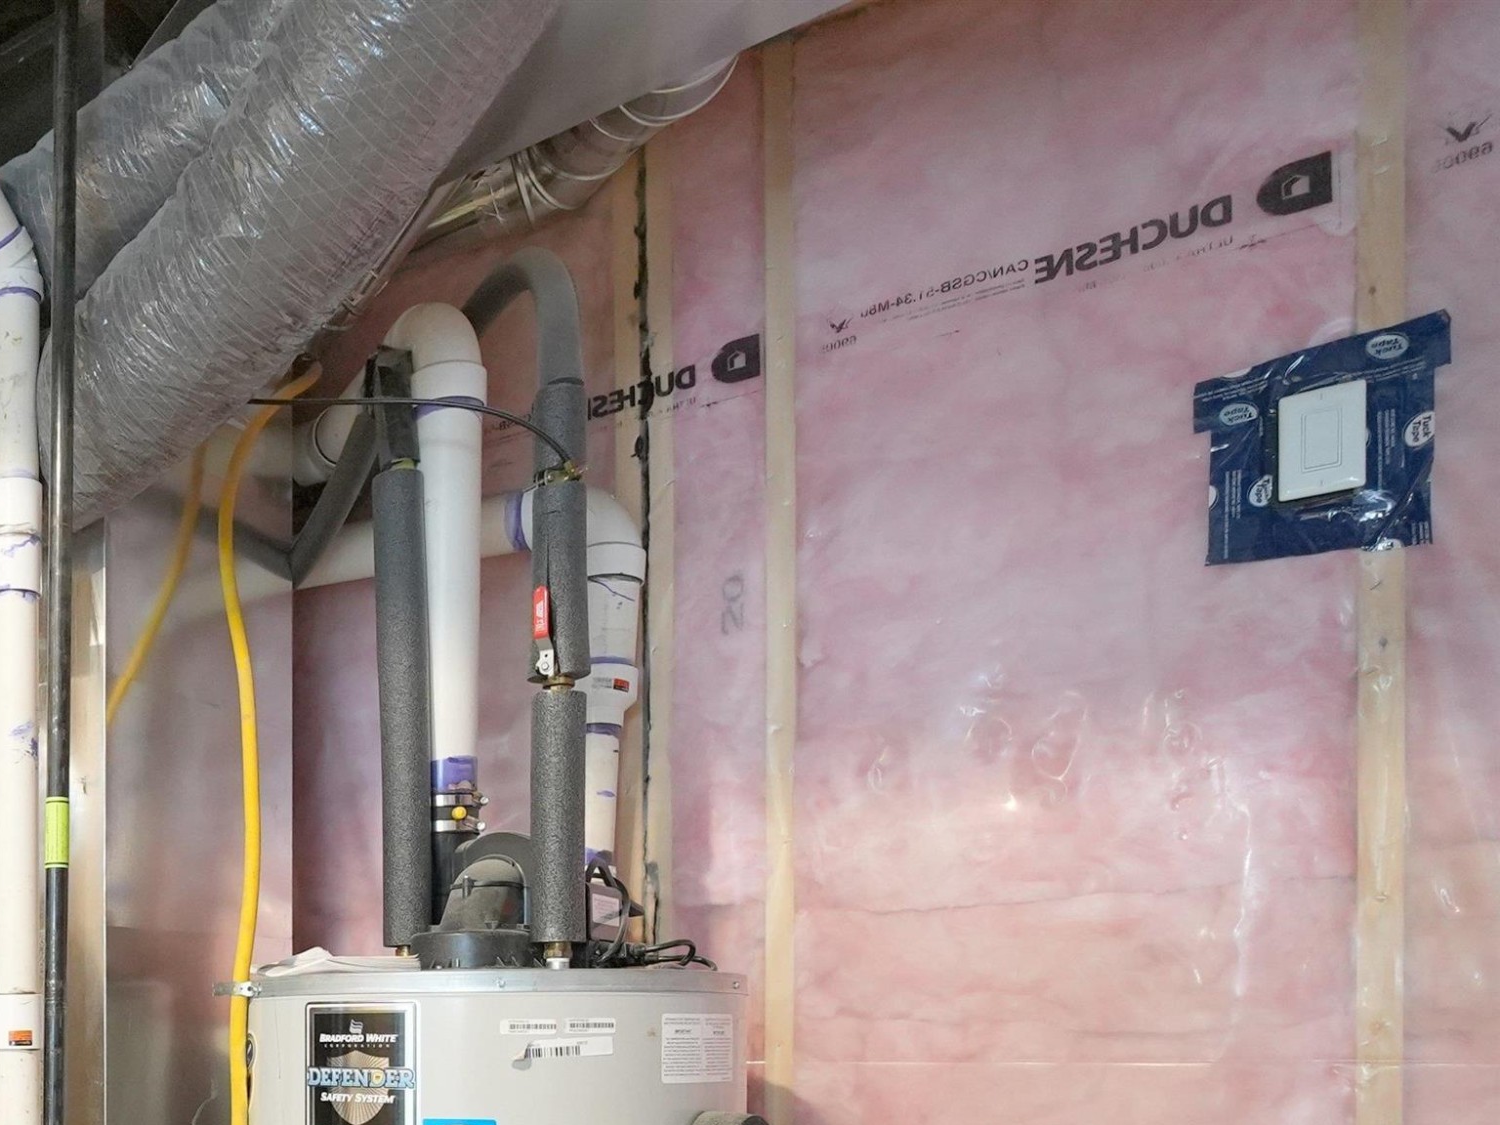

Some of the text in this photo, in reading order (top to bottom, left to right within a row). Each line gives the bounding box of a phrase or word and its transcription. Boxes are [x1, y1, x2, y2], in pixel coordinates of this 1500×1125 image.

[1412, 419, 1422, 443] Tape
[1421, 414, 1432, 438] Tuck
[1255, 484, 1264, 503] Tape
[319, 1033, 397, 1043] BRADFORD WHITE
[307, 1067, 415, 1090] DEFENDER
[320, 1092, 394, 1104] SAFETY SYSTEM
